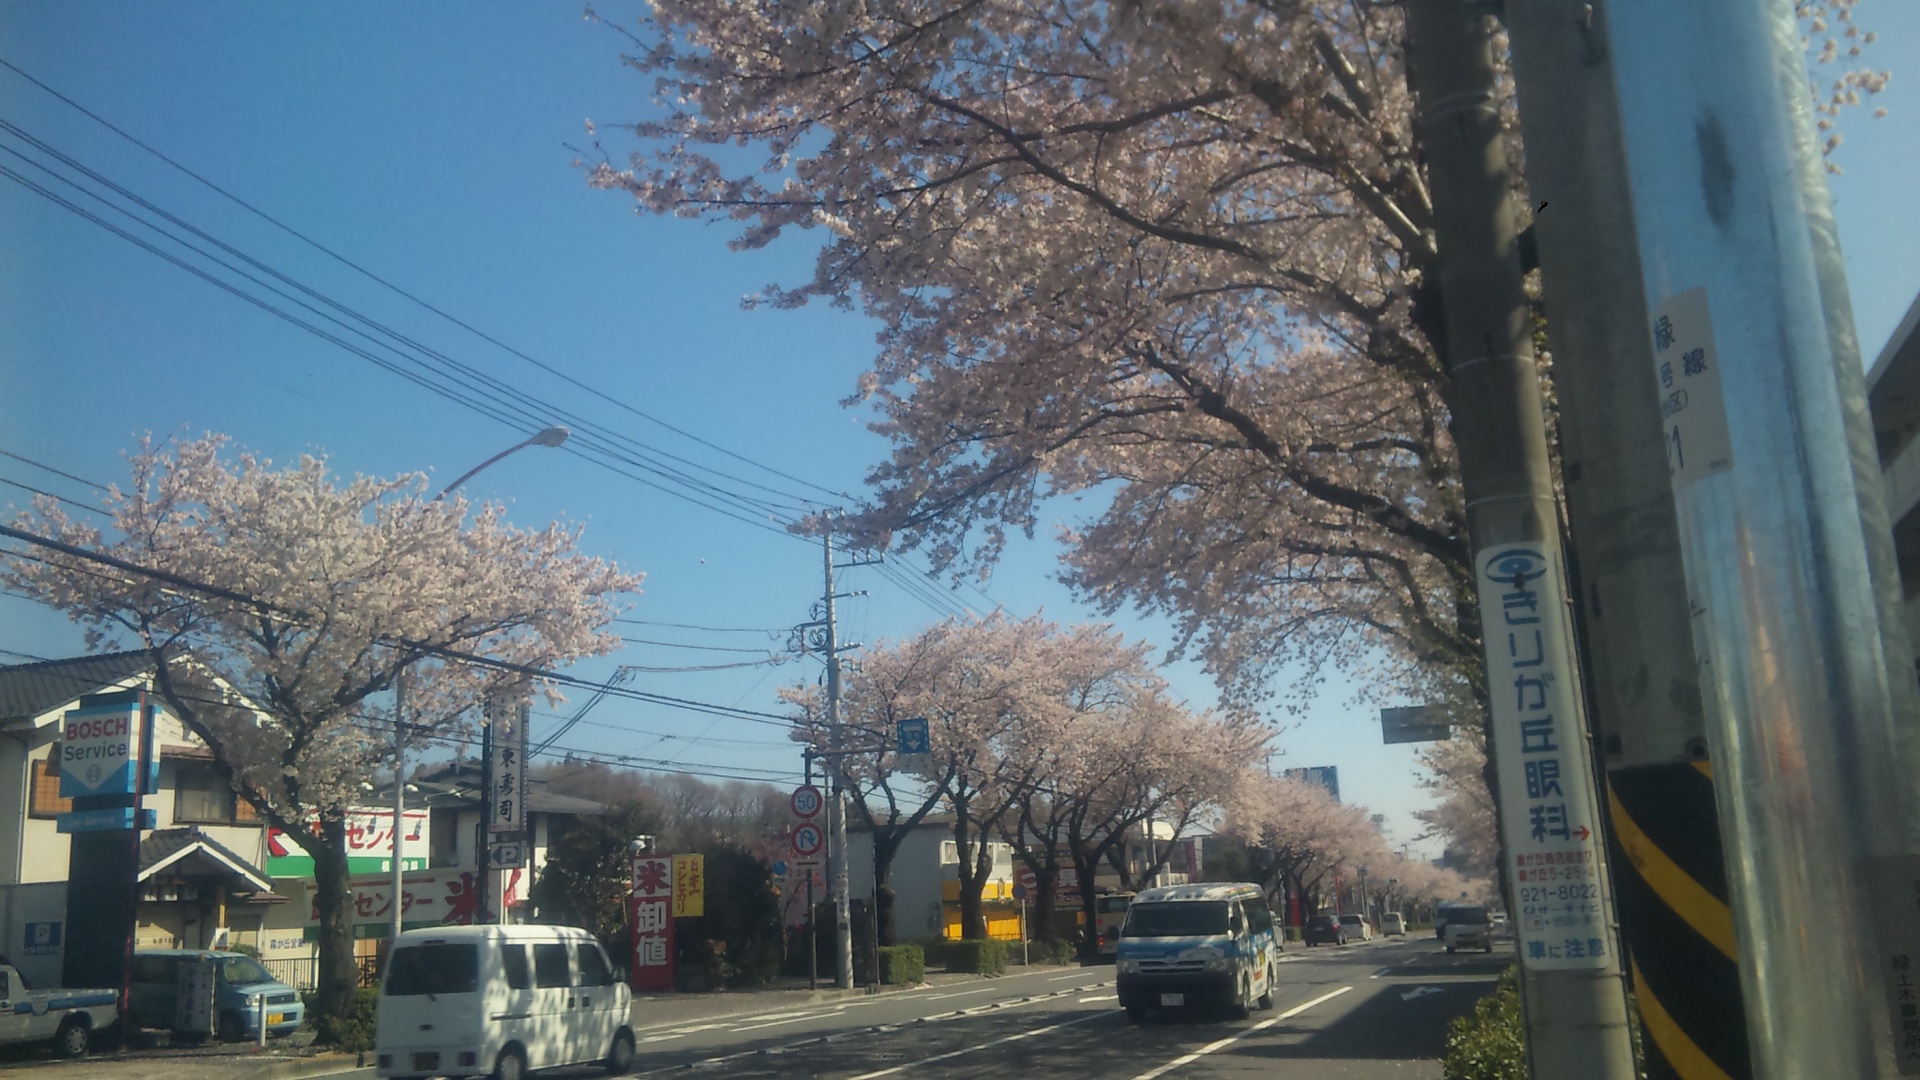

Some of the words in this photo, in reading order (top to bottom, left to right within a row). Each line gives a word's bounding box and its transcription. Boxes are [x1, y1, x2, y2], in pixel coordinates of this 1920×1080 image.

[1502, 592, 1571, 842] きりが丘眼科
[65, 717, 129, 741] BOSCH
[63, 741, 128, 762] Service
[499, 745, 517, 823] 東寿司
[797, 794, 816, 810] 50
[1520, 885, 1599, 903] 921-8022
[1526, 937, 1605, 960] 車に注意
